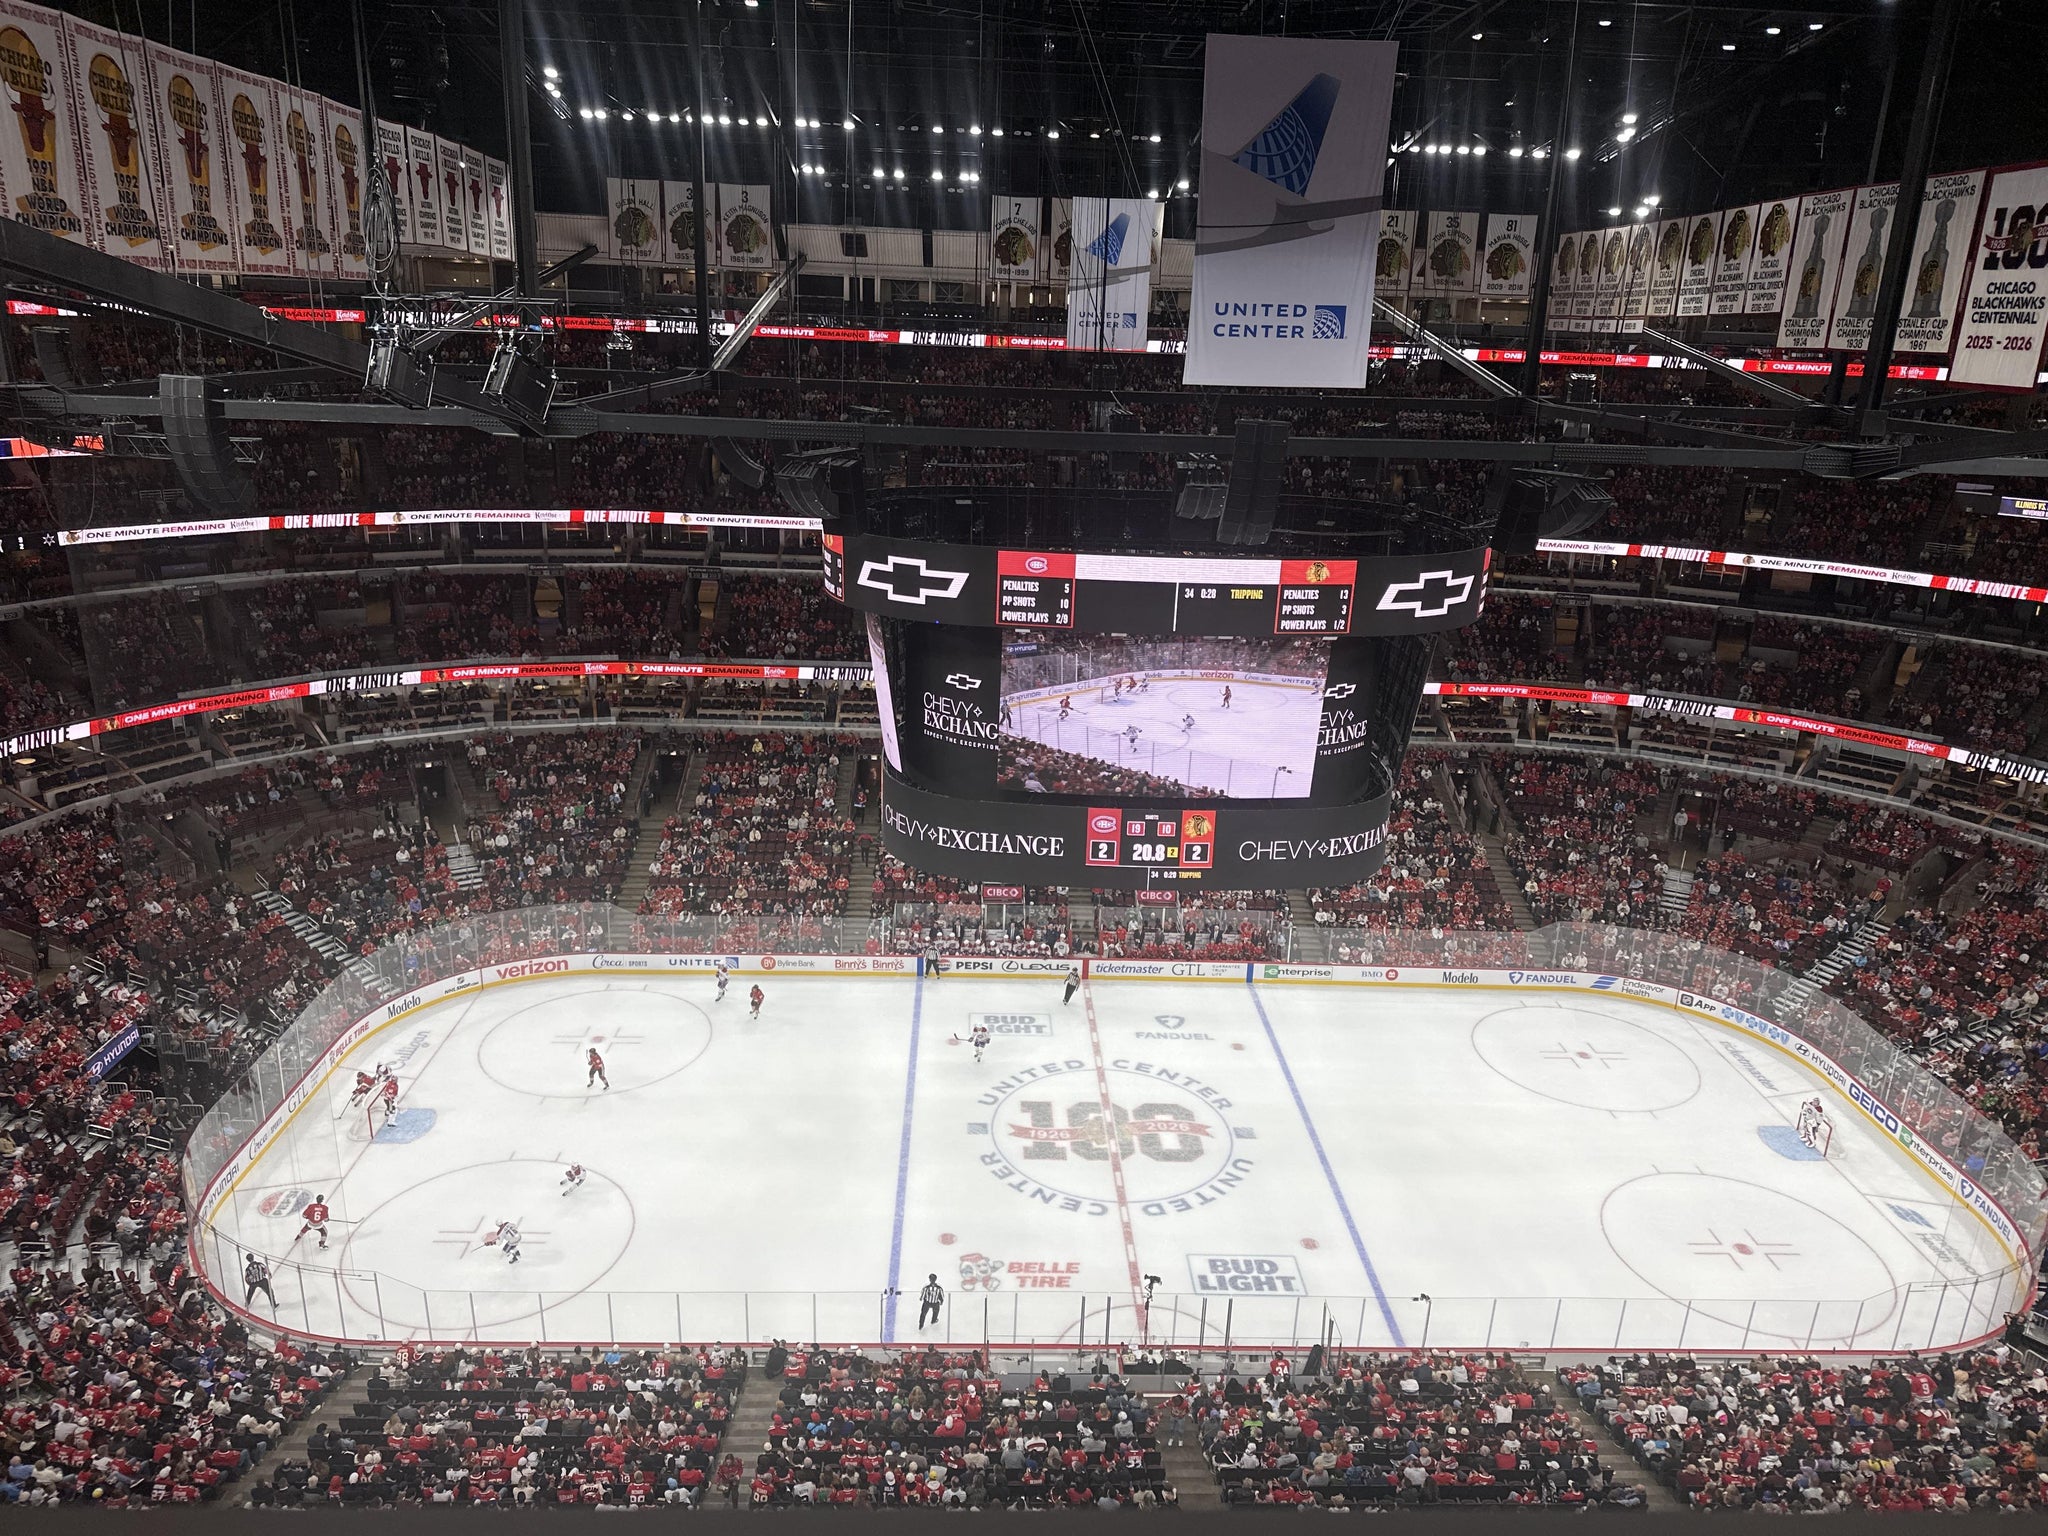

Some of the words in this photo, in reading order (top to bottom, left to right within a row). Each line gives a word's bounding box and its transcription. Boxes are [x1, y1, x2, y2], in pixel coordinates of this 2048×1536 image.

[27, 158, 54, 177] 1991
[31, 176, 57, 194] NBA
[113, 171, 139, 189] 1992
[1932, 174, 1970, 190] CHICAGO
[118, 190, 138, 204] NBA
[741, 190, 749, 203] 3
[1811, 193, 1842, 206] CHICAGO
[1923, 185, 1977, 202] BLACKHAWKS
[722, 207, 738, 223] KEITH
[738, 204, 769, 224] MAGNUSON
[1014, 202, 1022, 216] 7
[1803, 202, 1847, 218] BLACKHAWKS
[995, 216, 1012, 231] CHRIS
[1012, 216, 1037, 236] CHELIOS
[1446, 216, 1460, 229] 35
[1506, 219, 1518, 232] 81
[1432, 230, 1447, 244] TONY
[1487, 233, 1512, 249] MARIAN
[1512, 232, 1530, 249] HOSSA
[1986, 281, 2037, 295] CHICAGO
[1214, 302, 1307, 318] UNITED
[1971, 296, 2046, 311] BLACKHAWKS
[1783, 318, 1809, 329] STANLEY
[1810, 318, 1826, 330] CUP
[1835, 318, 1866, 329] STANLEY
[1899, 318, 1931, 329] STANLEY
[1931, 318, 1949, 330] CUP
[1971, 311, 2038, 325] CENTENNIAL
[760, 327, 779, 335] ONE
[780, 328, 815, 337] MINUTE
[815, 330, 866, 339] REMAINING
[1213, 323, 1305, 339] CENTER
[1784, 328, 1821, 338] CHAMPIONS
[1898, 329, 1944, 341] CHAMPIONS
[1846, 338, 1864, 349] 1938
[1909, 340, 1927, 351] 1961
[1965, 335, 1994, 349] 2025
[2003, 336, 2032, 350] 2026
[1560, 354, 1612, 363] REMAINING
[284, 516, 310, 529] ONE
[311, 513, 360, 528] MINUTE
[753, 518, 805, 526] REMAINING
[86, 530, 112, 539] ONE
[114, 527, 160, 538] MINUTE
[161, 522, 226, 534] REMAINING
[1760, 558, 1782, 567] ONE
[1783, 560, 1825, 571] MINUTE
[1826, 564, 1887, 578] REMAINING
[1002, 580, 1039, 592] PENALTIES
[1064, 583, 1070, 594] 5
[1184, 588, 1194, 599] 34
[1230, 589, 1264, 600] TRIPPING
[1946, 577, 1975, 594] ONE
[1975, 580, 2031, 600] MINUTE
[1283, 589, 1320, 600] PENALTIES
[1339, 589, 1349, 600] 13
[1002, 595, 1012, 606] PP
[1013, 596, 1036, 608] SHOTS
[1060, 598, 1069, 609] 10
[1282, 604, 1292, 615] PP
[1292, 605, 1315, 616] SHOTS
[1341, 605, 1347, 615] 3
[1002, 611, 1027, 622] POWER
[1027, 612, 1049, 624] PLAYS
[1056, 613, 1069, 624] 2/9
[1280, 619, 1305, 630] POWER
[1305, 620, 1327, 631] PLAYS
[1333, 619, 1345, 630] 1/2
[452, 668, 476, 677] ONE
[477, 667, 520, 676] MINUTE
[521, 665, 581, 674] REMAINING
[665, 665, 703, 673] MINUTE
[704, 667, 760, 675] REMAINING
[1199, 671, 1234, 680] verizon
[1468, 685, 1490, 693] ONE
[1490, 686, 1528, 694] MINUTE
[1529, 689, 1588, 699] REMAINING
[124, 711, 150, 724] ONE
[151, 702, 196, 718] MINUTE
[197, 692, 266, 709] REMAINING
[923, 691, 973, 719] CHEVY
[1642, 696, 1668, 710] ONE
[1670, 698, 1718, 717] MINUTE
[924, 708, 999, 740] EXCHANG
[1766, 715, 1791, 725] ONE
[1791, 719, 1836, 734] MINUTE
[1836, 727, 1902, 746] REMAINING
[945, 736, 957, 744] THE
[884, 803, 930, 841] CHEVY
[937, 826, 1064, 857] EXCHANGE
[1131, 824, 1141, 833] 19
[1162, 824, 1171, 834] 10
[1098, 843, 1108, 859] 2
[1132, 844, 1165, 862] 20.8
[1191, 845, 1202, 861] 2
[1238, 840, 1320, 861] CHEVY
[1178, 871, 1202, 879] TRIPPING
[986, 887, 1009, 898] CIBC
[1140, 891, 1162, 900] CIBC
[592, 954, 624, 969] Circa
[628, 959, 648, 968] SPORTS
[777, 959, 796, 970] Byline
[798, 959, 815, 968] Bank
[834, 957, 868, 971] Binny's
[872, 958, 905, 971] Binny's
[955, 961, 993, 970] PEPSI
[1020, 963, 1070, 971] LEXUS
[496, 958, 570, 980] verizon
[1095, 963, 1164, 975] ticketmaster
[1171, 963, 1206, 976] GTL
[1361, 970, 1383, 978] BMO
[1442, 971, 1479, 984] Modelo
[1525, 974, 1577, 984] FANDUEL
[1621, 986, 1650, 998] Health
[1622, 979, 1665, 994] Endeavor
[387, 995, 421, 1020] Modelo
[983, 1015, 1036, 1025] BUD
[336, 1035, 353, 1058] BELLE
[354, 1021, 370, 1039] TIRE
[1135, 1031, 1215, 1041] FANDUEL
[103, 1030, 140, 1066] HYUNDAI
[1811, 1053, 1847, 1087] HYUNDAI
[977, 1058, 1086, 1107] UNITED
[1112, 1058, 1234, 1112] CENTER
[287, 1084, 309, 1115] GTL
[1848, 1082, 1899, 1134] GEICO
[1019, 1100, 1206, 1163] 100
[1146, 1121, 1191, 1132] 2026
[1028, 1129, 1071, 1140] 1926
[208, 1163, 240, 1209] HYUNDAI
[979, 1151, 1109, 1218] CENTER
[1141, 1157, 1254, 1217] UNITED
[313, 1211, 321, 1221] 6
[1974, 1193, 2012, 1242] FANDUEL
[1007, 1262, 1081, 1274] BELLE
[1207, 1258, 1279, 1275] BUD
[1016, 1276, 1072, 1288] TIRE
[1197, 1274, 1297, 1292] LIGHT
[396, 1352, 408, 1363] 98
